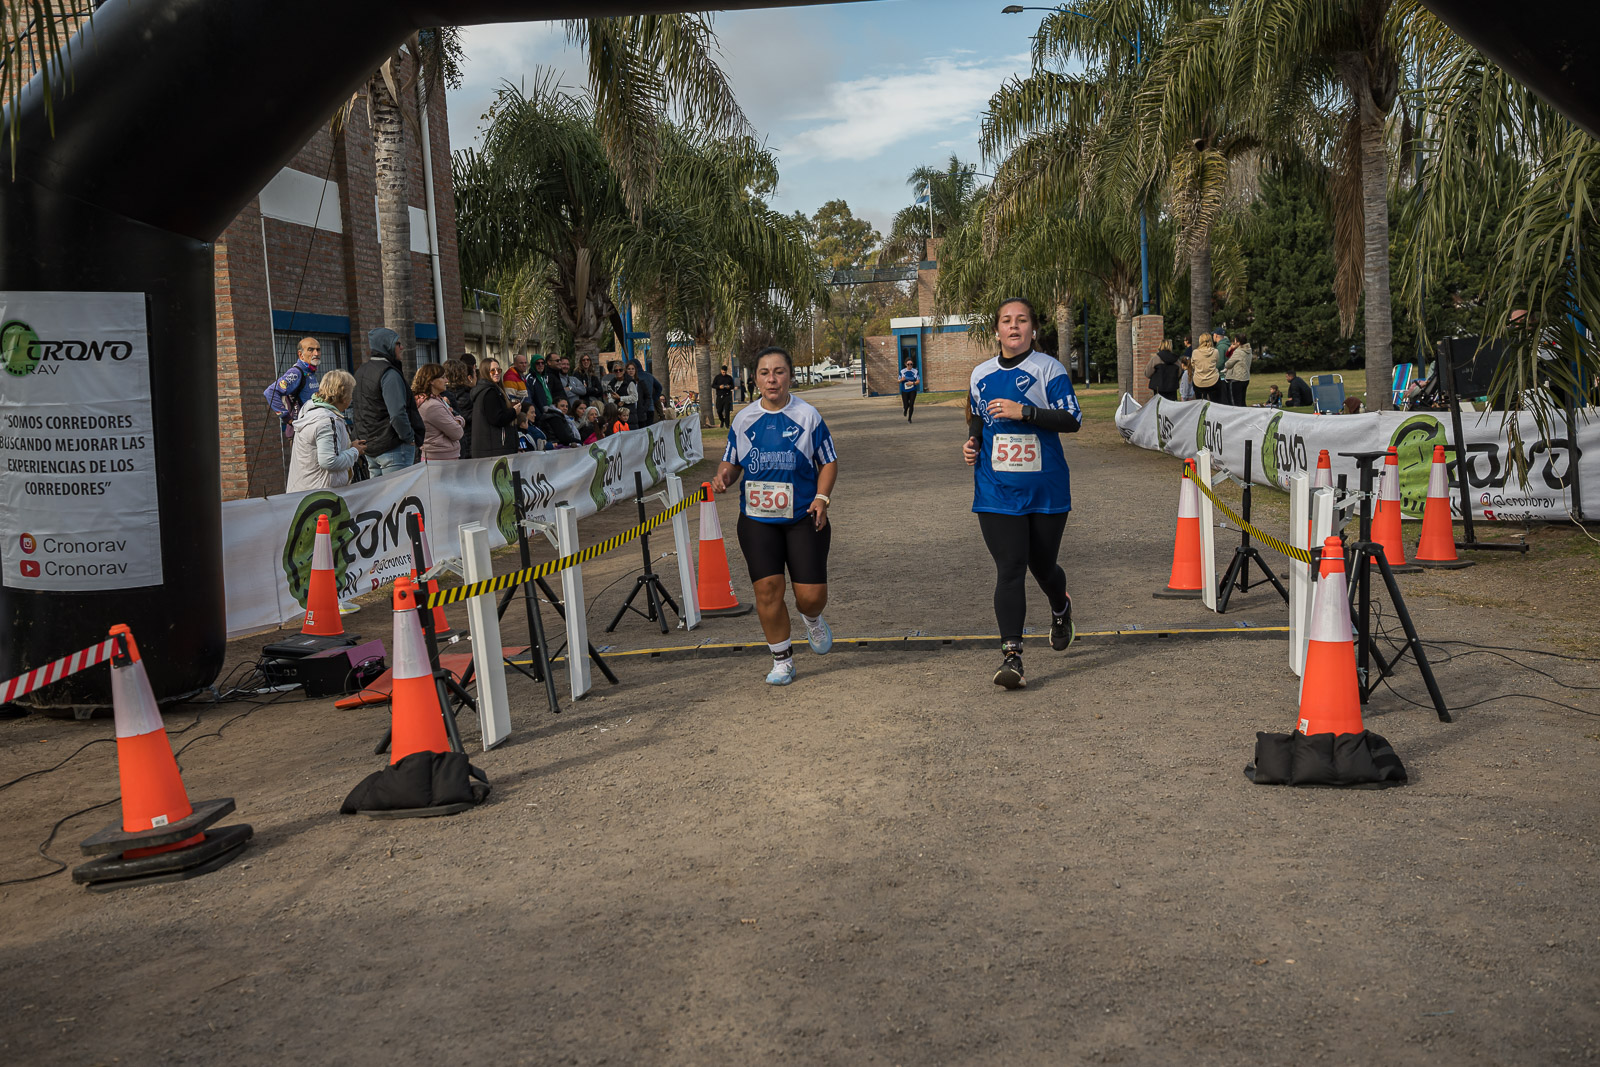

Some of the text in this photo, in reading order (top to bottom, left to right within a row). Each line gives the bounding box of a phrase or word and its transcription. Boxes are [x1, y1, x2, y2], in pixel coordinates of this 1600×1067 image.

[27, 340, 133, 361] CRONO
[25, 364, 60, 375] RAV
[45, 415, 133, 430] CORREDORES
[0, 435, 146, 452] BUSCANDO MEJORAR LAS
[748, 447, 760, 474] 3
[996, 443, 1037, 463] 525
[7, 458, 135, 474] EXPERIENCIAS DE LOS
[25, 481, 111, 496] CORREDORES”
[749, 490, 789, 510] 530
[1493, 494, 1556, 508] @cronorav
[43, 538, 127, 554] Cronorav
[44, 560, 128, 577] Cronorav
